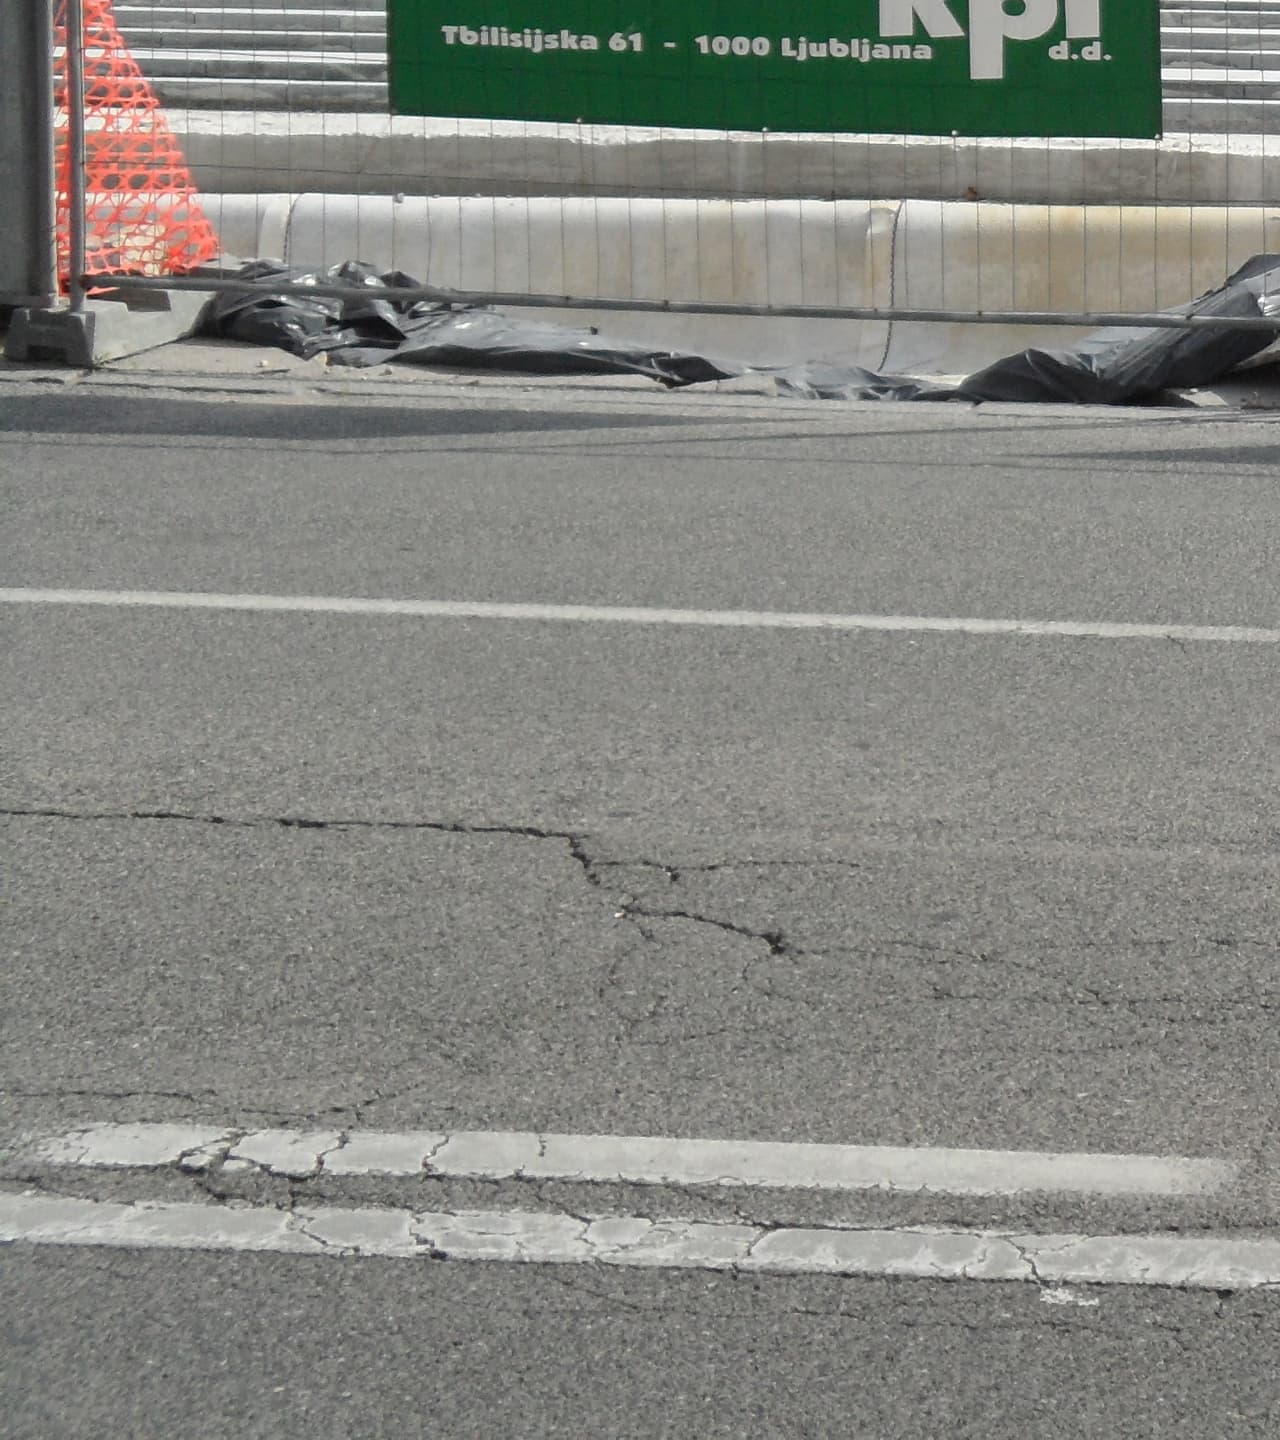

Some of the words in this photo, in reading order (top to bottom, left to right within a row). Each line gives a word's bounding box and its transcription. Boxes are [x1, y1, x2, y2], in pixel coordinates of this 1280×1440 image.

[441, 25, 598, 51] Tbilisijska
[608, 31, 642, 51] 61
[695, 36, 770, 57] 1000
[780, 36, 933, 63] Ljubljana
[1048, 40, 1112, 61] d.d.
